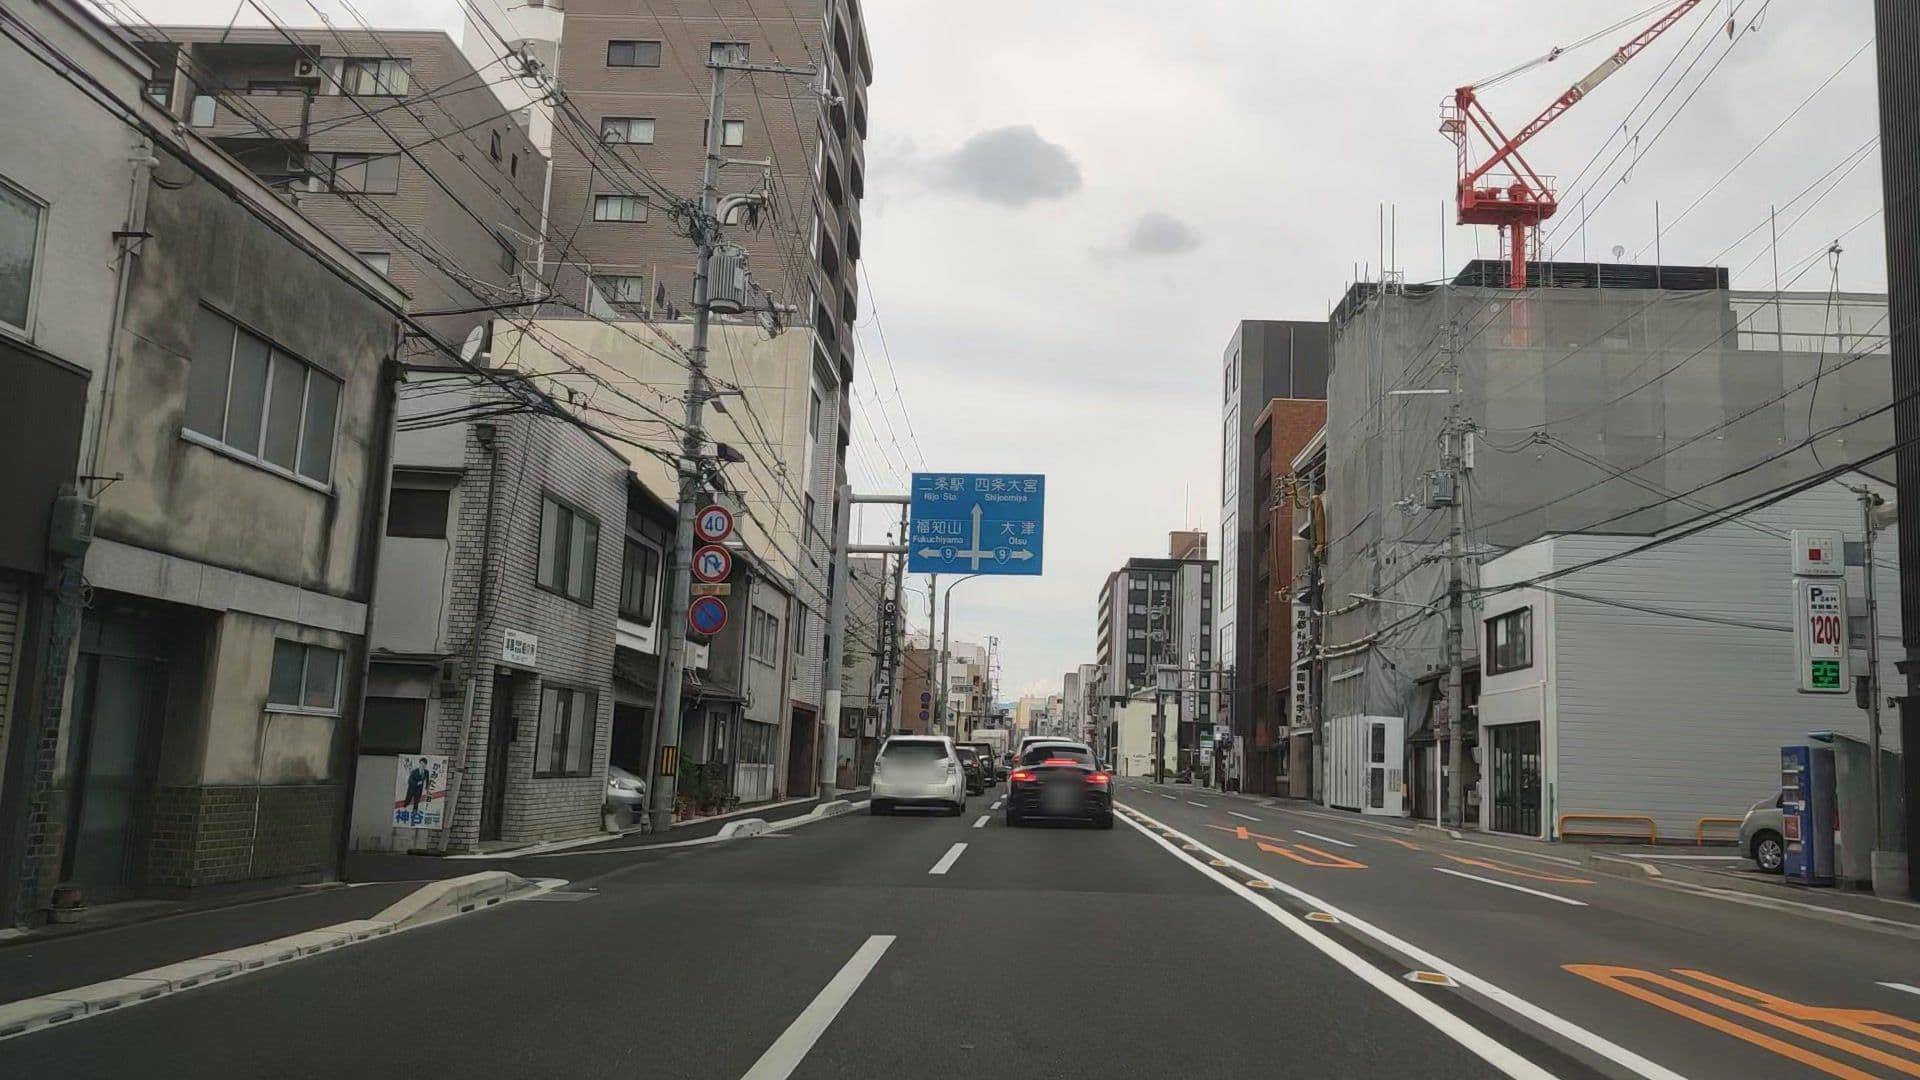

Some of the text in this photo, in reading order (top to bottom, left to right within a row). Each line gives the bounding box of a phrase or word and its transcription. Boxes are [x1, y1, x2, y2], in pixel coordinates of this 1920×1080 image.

[919, 477, 1038, 493] 二条駅 四条大宮
[924, 492, 940, 502] Nijo
[984, 493, 1028, 503] Shijoomiya
[705, 516, 725, 532] 40
[916, 520, 962, 535] 福知山
[1001, 521, 1036, 536] 大津
[912, 535, 964, 544] Fukuchiyama
[1008, 537, 1028, 545] Otsu
[945, 548, 952, 557] 9
[999, 550, 1006, 559] 9
[1811, 588, 1823, 602] P
[1810, 615, 1840, 645] 1200
